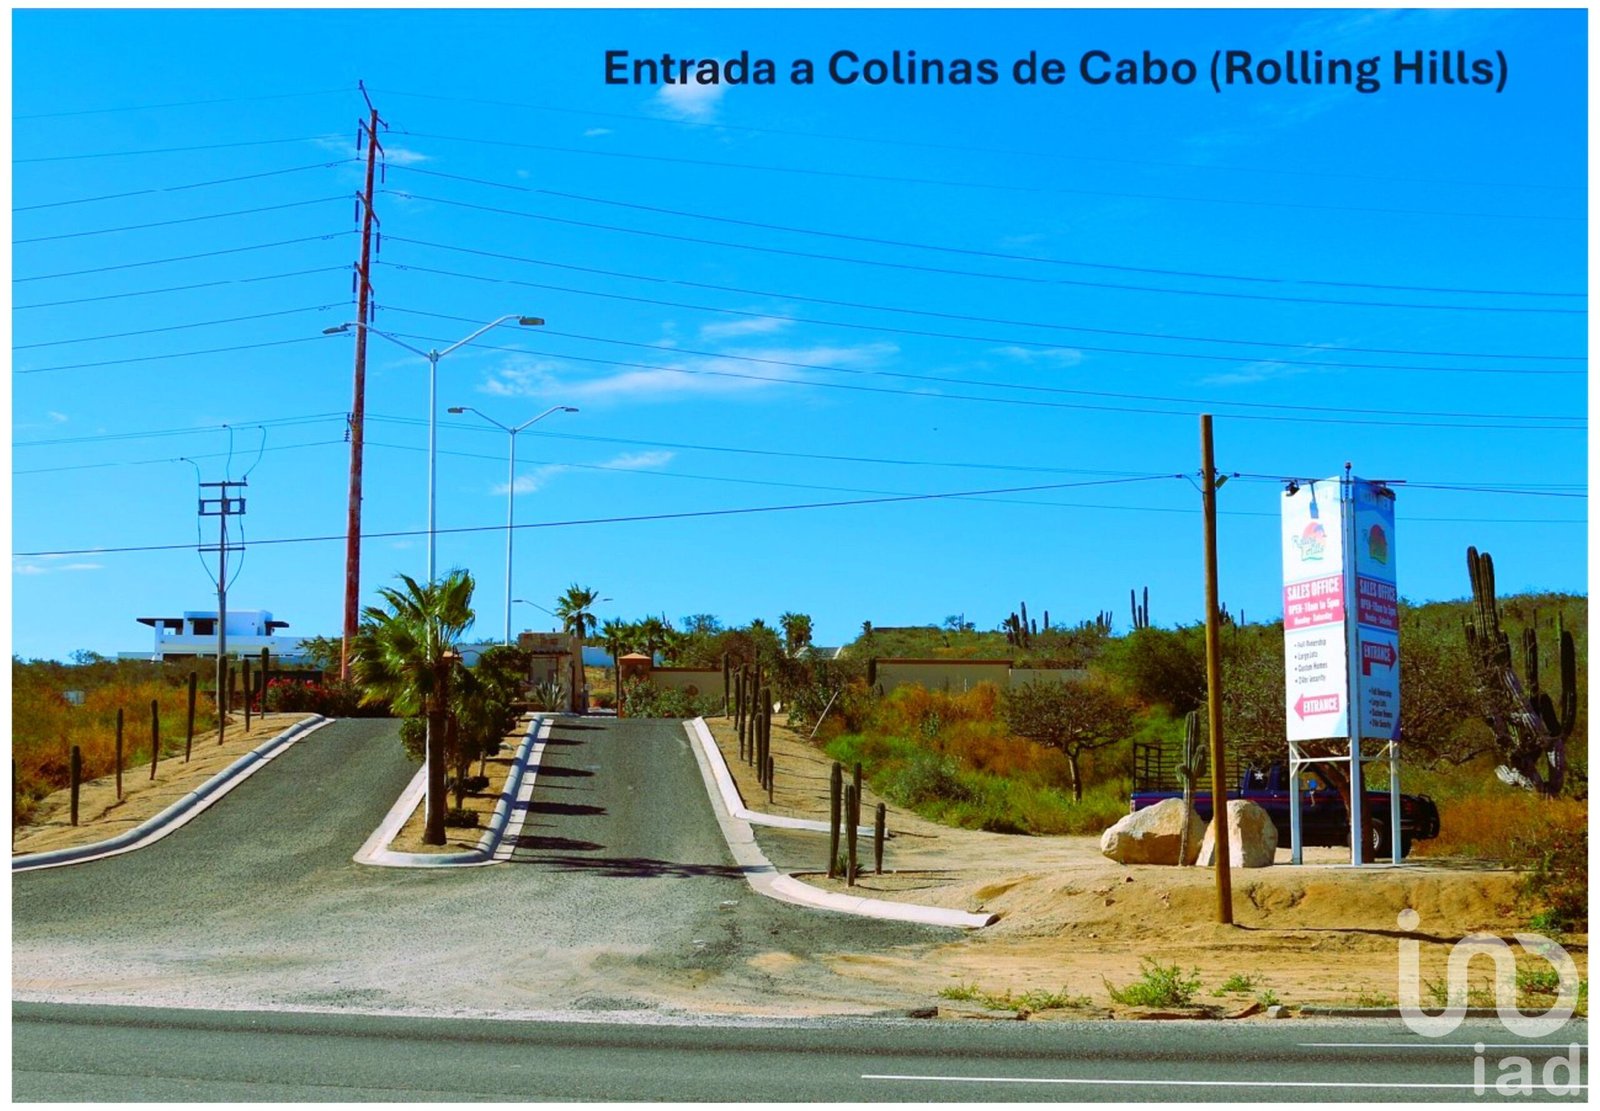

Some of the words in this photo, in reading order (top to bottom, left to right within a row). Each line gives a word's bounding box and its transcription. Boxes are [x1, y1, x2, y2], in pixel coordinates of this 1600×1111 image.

[1287, 583, 1310, 601] SALES
[1311, 577, 1339, 596] OFFICE
[1359, 579, 1377, 597] SALES
[1377, 583, 1396, 602] OFFICE
[1364, 645, 1391, 662] ENTRANCE
[1303, 697, 1338, 713] ENTRANCE
